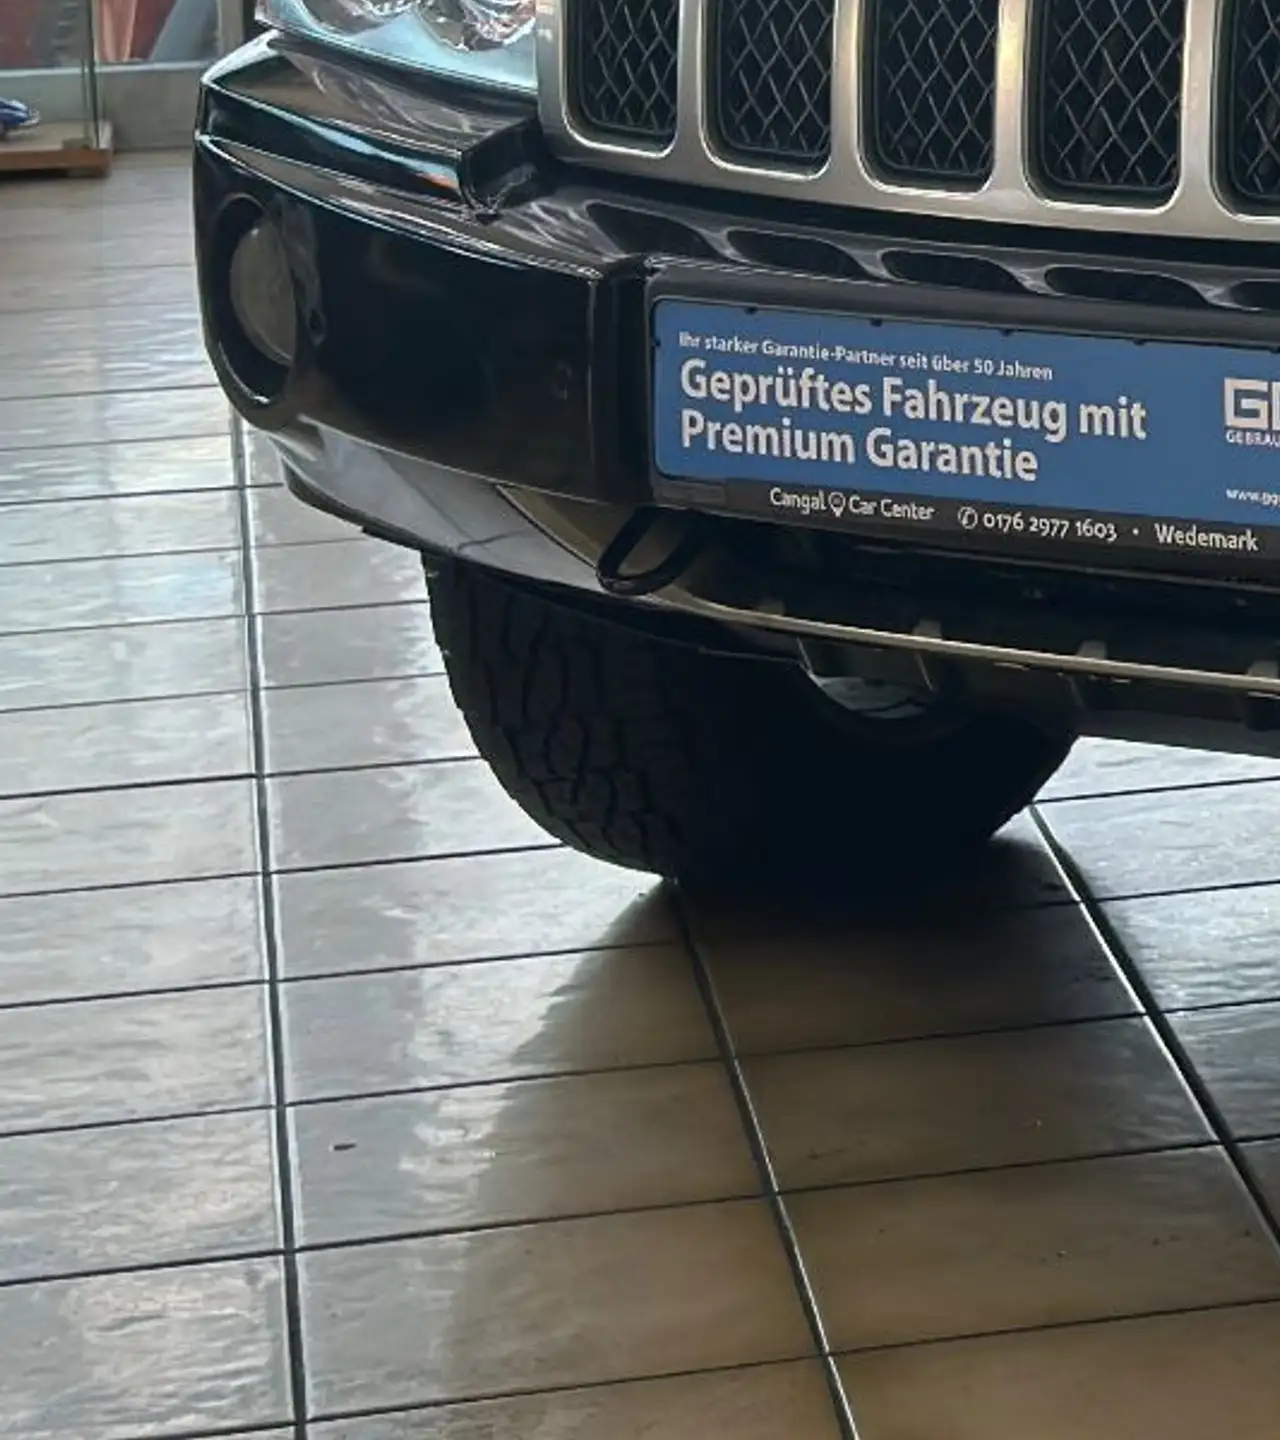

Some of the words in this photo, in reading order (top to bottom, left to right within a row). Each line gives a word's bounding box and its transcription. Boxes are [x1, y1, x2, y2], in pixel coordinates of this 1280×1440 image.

[679, 331, 701, 348] Ihr
[704, 335, 759, 356] starker
[762, 339, 896, 368] Garantie-Partner
[899, 351, 929, 371] seit
[932, 353, 970, 374] über
[973, 357, 994, 376] 50
[997, 359, 1054, 382] Jahren
[680, 357, 873, 414] Geprüftes
[883, 376, 1068, 444] Fahrzeug
[1079, 395, 1147, 441] mit
[681, 408, 856, 465] Premium
[866, 427, 1039, 483] Garantie
[769, 486, 827, 515] Cangal
[849, 496, 876, 515] Car
[880, 498, 936, 521] Center
[982, 511, 1025, 534] 0176
[1029, 516, 1070, 539] 2977
[1075, 518, 1118, 544] 1603
[1154, 522, 1259, 552] Wedemark
